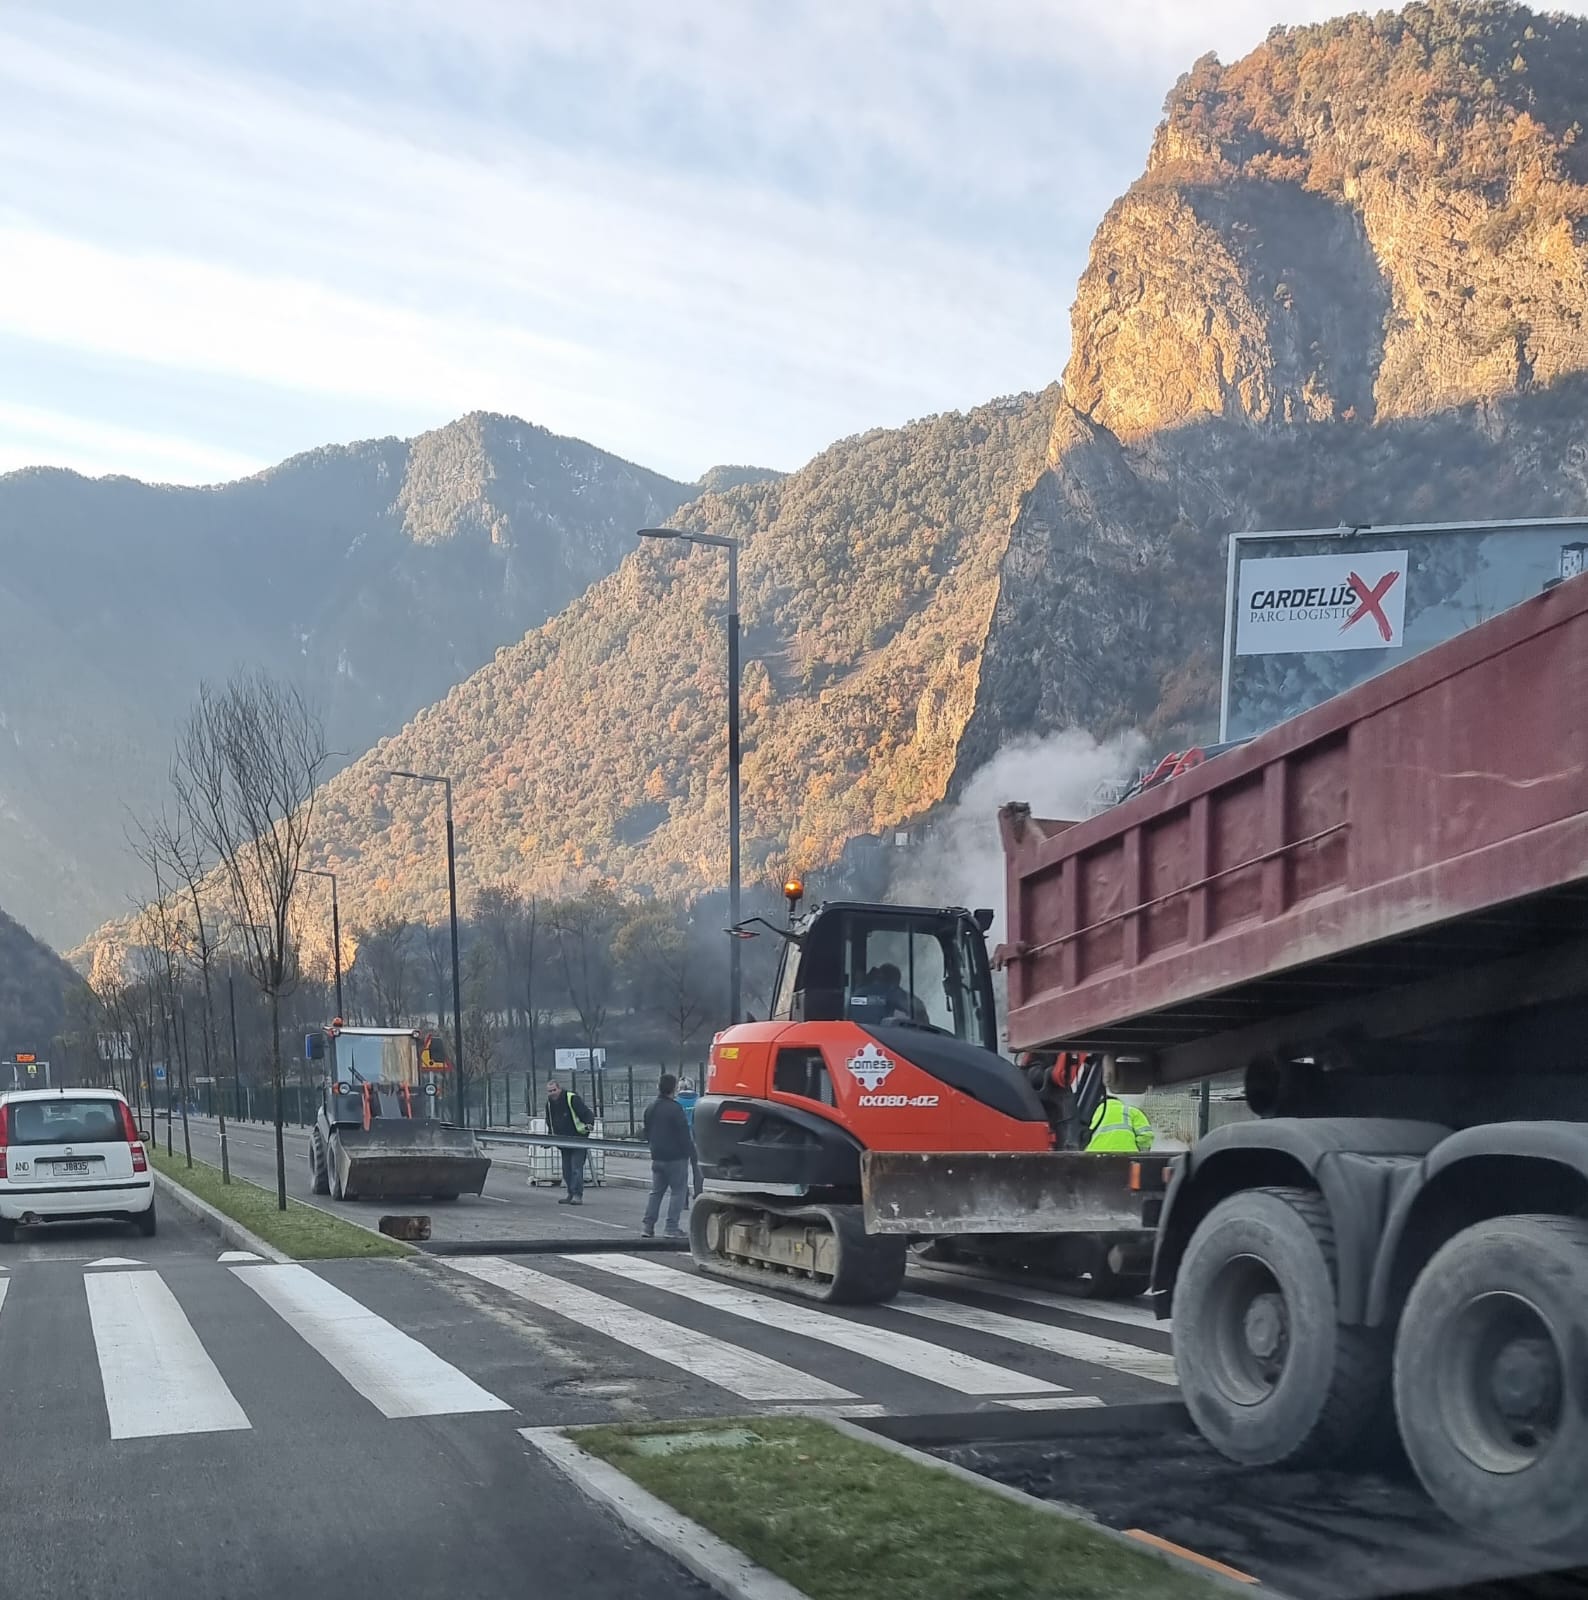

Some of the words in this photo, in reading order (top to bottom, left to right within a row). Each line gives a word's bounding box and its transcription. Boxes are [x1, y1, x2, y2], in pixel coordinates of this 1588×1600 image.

[1250, 609, 1285, 623] PARC
[847, 1058, 894, 1070] Comesa
[15, 1161, 30, 1171] AND
